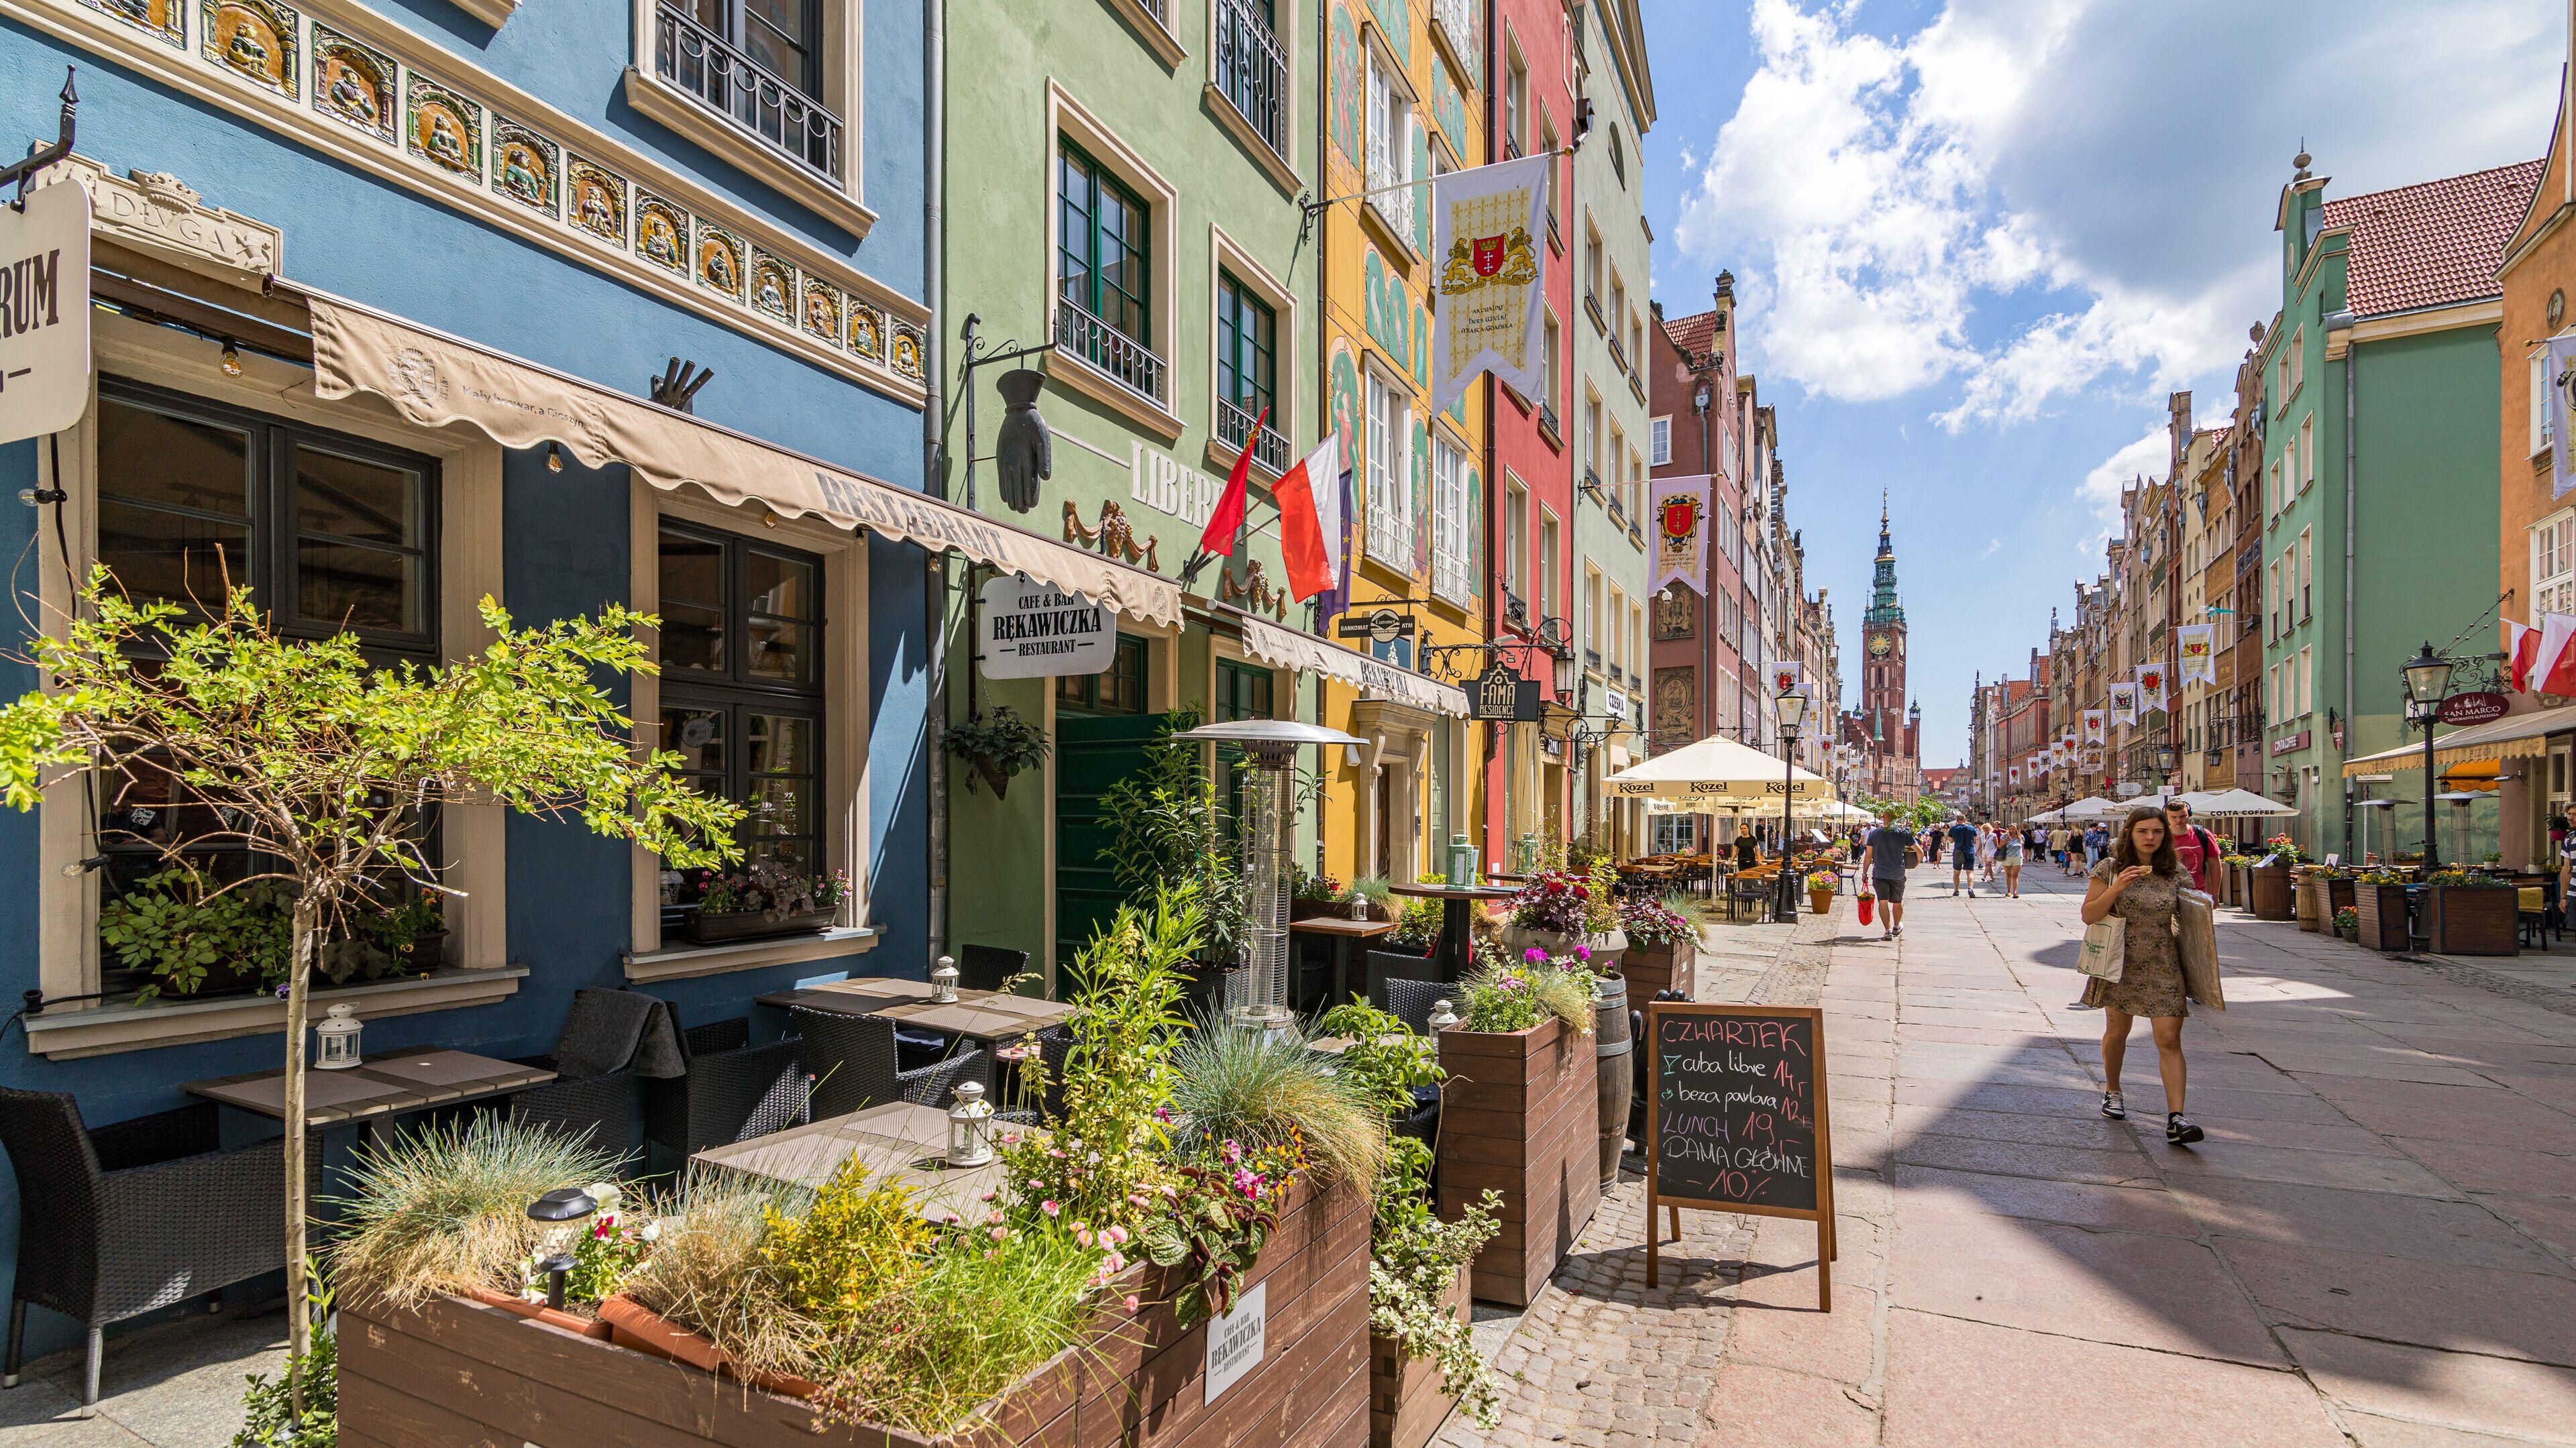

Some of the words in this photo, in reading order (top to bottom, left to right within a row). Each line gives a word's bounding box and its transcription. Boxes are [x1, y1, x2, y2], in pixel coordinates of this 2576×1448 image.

[814, 472, 1009, 562] RESTAURANT
[1018, 596, 1040, 610] CAFE
[1042, 594, 1051, 607] &
[1054, 593, 1074, 606] BAR
[993, 607, 1102, 643] RĘKAWICZKA
[1018, 639, 1076, 657] RESTAURANT
[1481, 682, 1516, 705] FAMA
[1608, 693, 1624, 712] CZESKA
[1479, 704, 1515, 714] RESIDENCE
[2445, 710, 2463, 718] SAN
[2465, 706, 2501, 716] MARCO
[1619, 782, 1655, 793] Kozel
[1690, 781, 1728, 793] Kozel
[1766, 782, 1805, 793] Koel
[1662, 1020, 1807, 1057] CZWARTEK
[1682, 1050, 1723, 1073] cuba
[1729, 1050, 1766, 1076] libre
[1678, 1080, 1721, 1103] beza
[1725, 1084, 1778, 1112] pavlova
[1663, 1111, 1730, 1144] LUNCH
[1224, 1323, 1235, 1338] CAFE
[1240, 1312, 1250, 1327] BAR
[1212, 1316, 1261, 1370] RĘKAWICZKA
[1224, 1344, 1250, 1373] RESTAURANT
